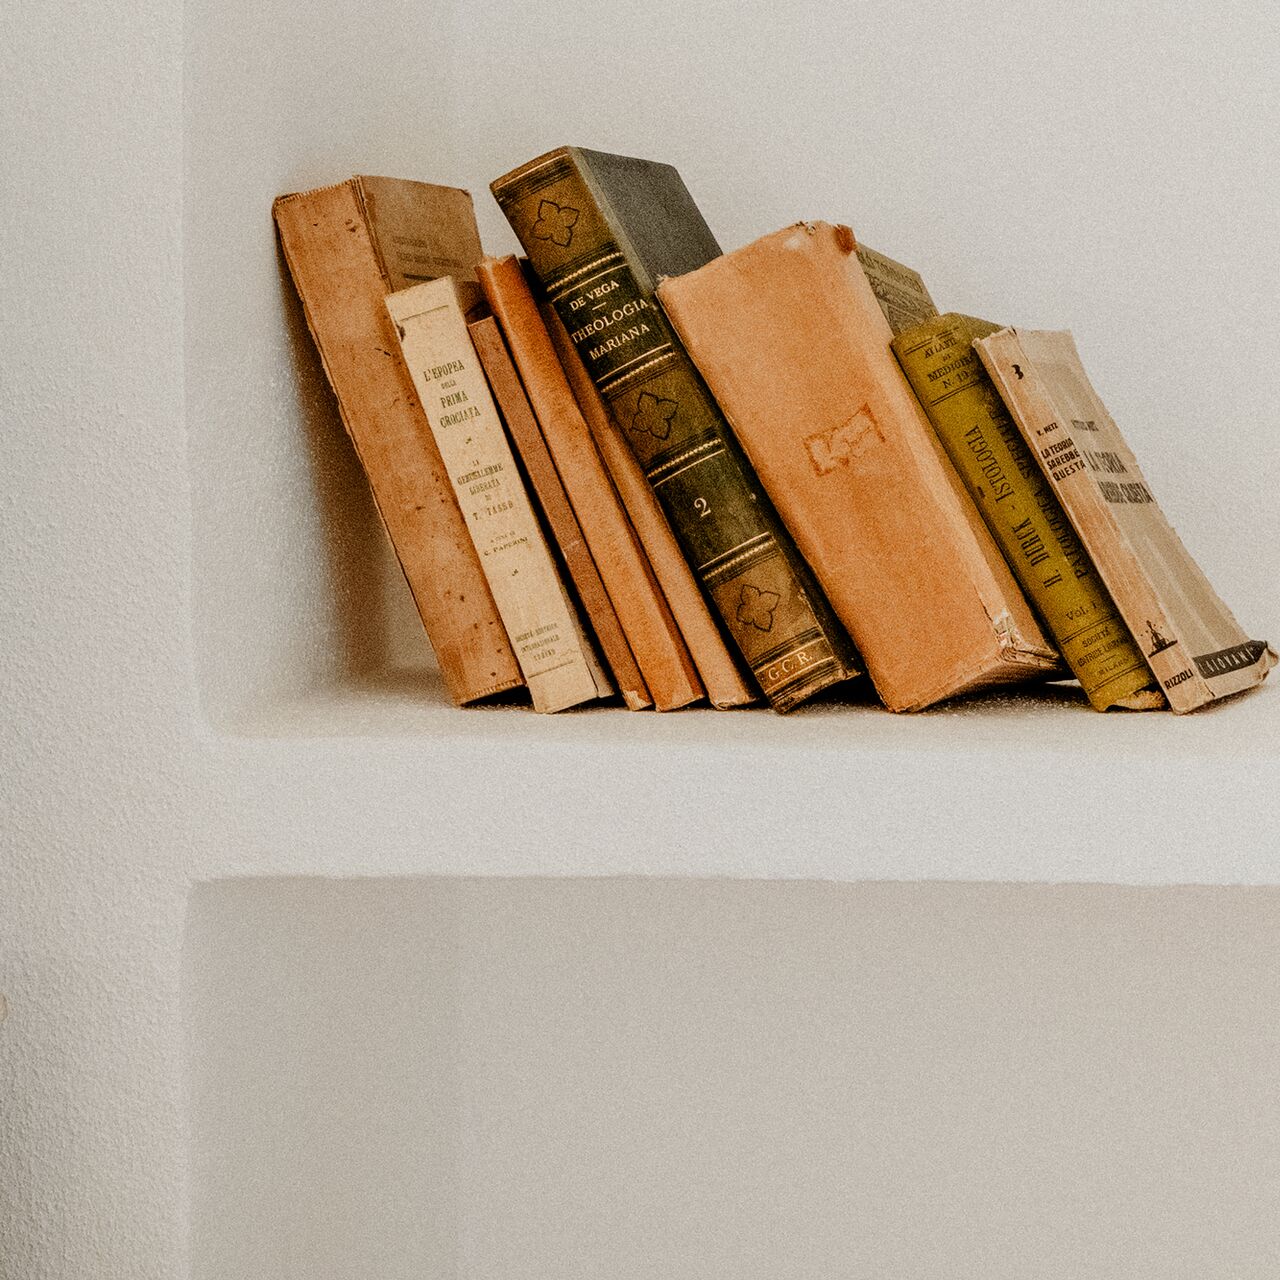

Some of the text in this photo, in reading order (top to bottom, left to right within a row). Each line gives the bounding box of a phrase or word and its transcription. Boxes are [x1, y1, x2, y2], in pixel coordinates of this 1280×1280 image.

[569, 280, 620, 312] DE VEGA
[571, 298, 649, 344] THEOLOGIA
[589, 323, 650, 360] MARIANA
[423, 359, 465, 382] L'EPOPEA
[927, 354, 976, 382] MEDICIN
[440, 390, 469, 408] PRIMA
[439, 406, 480, 428] CROCIATA
[1043, 422, 1059, 434] METZ
[1040, 437, 1075, 459] LA TEORIA
[1046, 448, 1080, 471] SAREBBE
[1052, 459, 1087, 482] QUESTA
[486, 500, 514, 516] TASSO
[694, 497, 712, 518] 2
[1164, 668, 1194, 690] RIZZOLI
